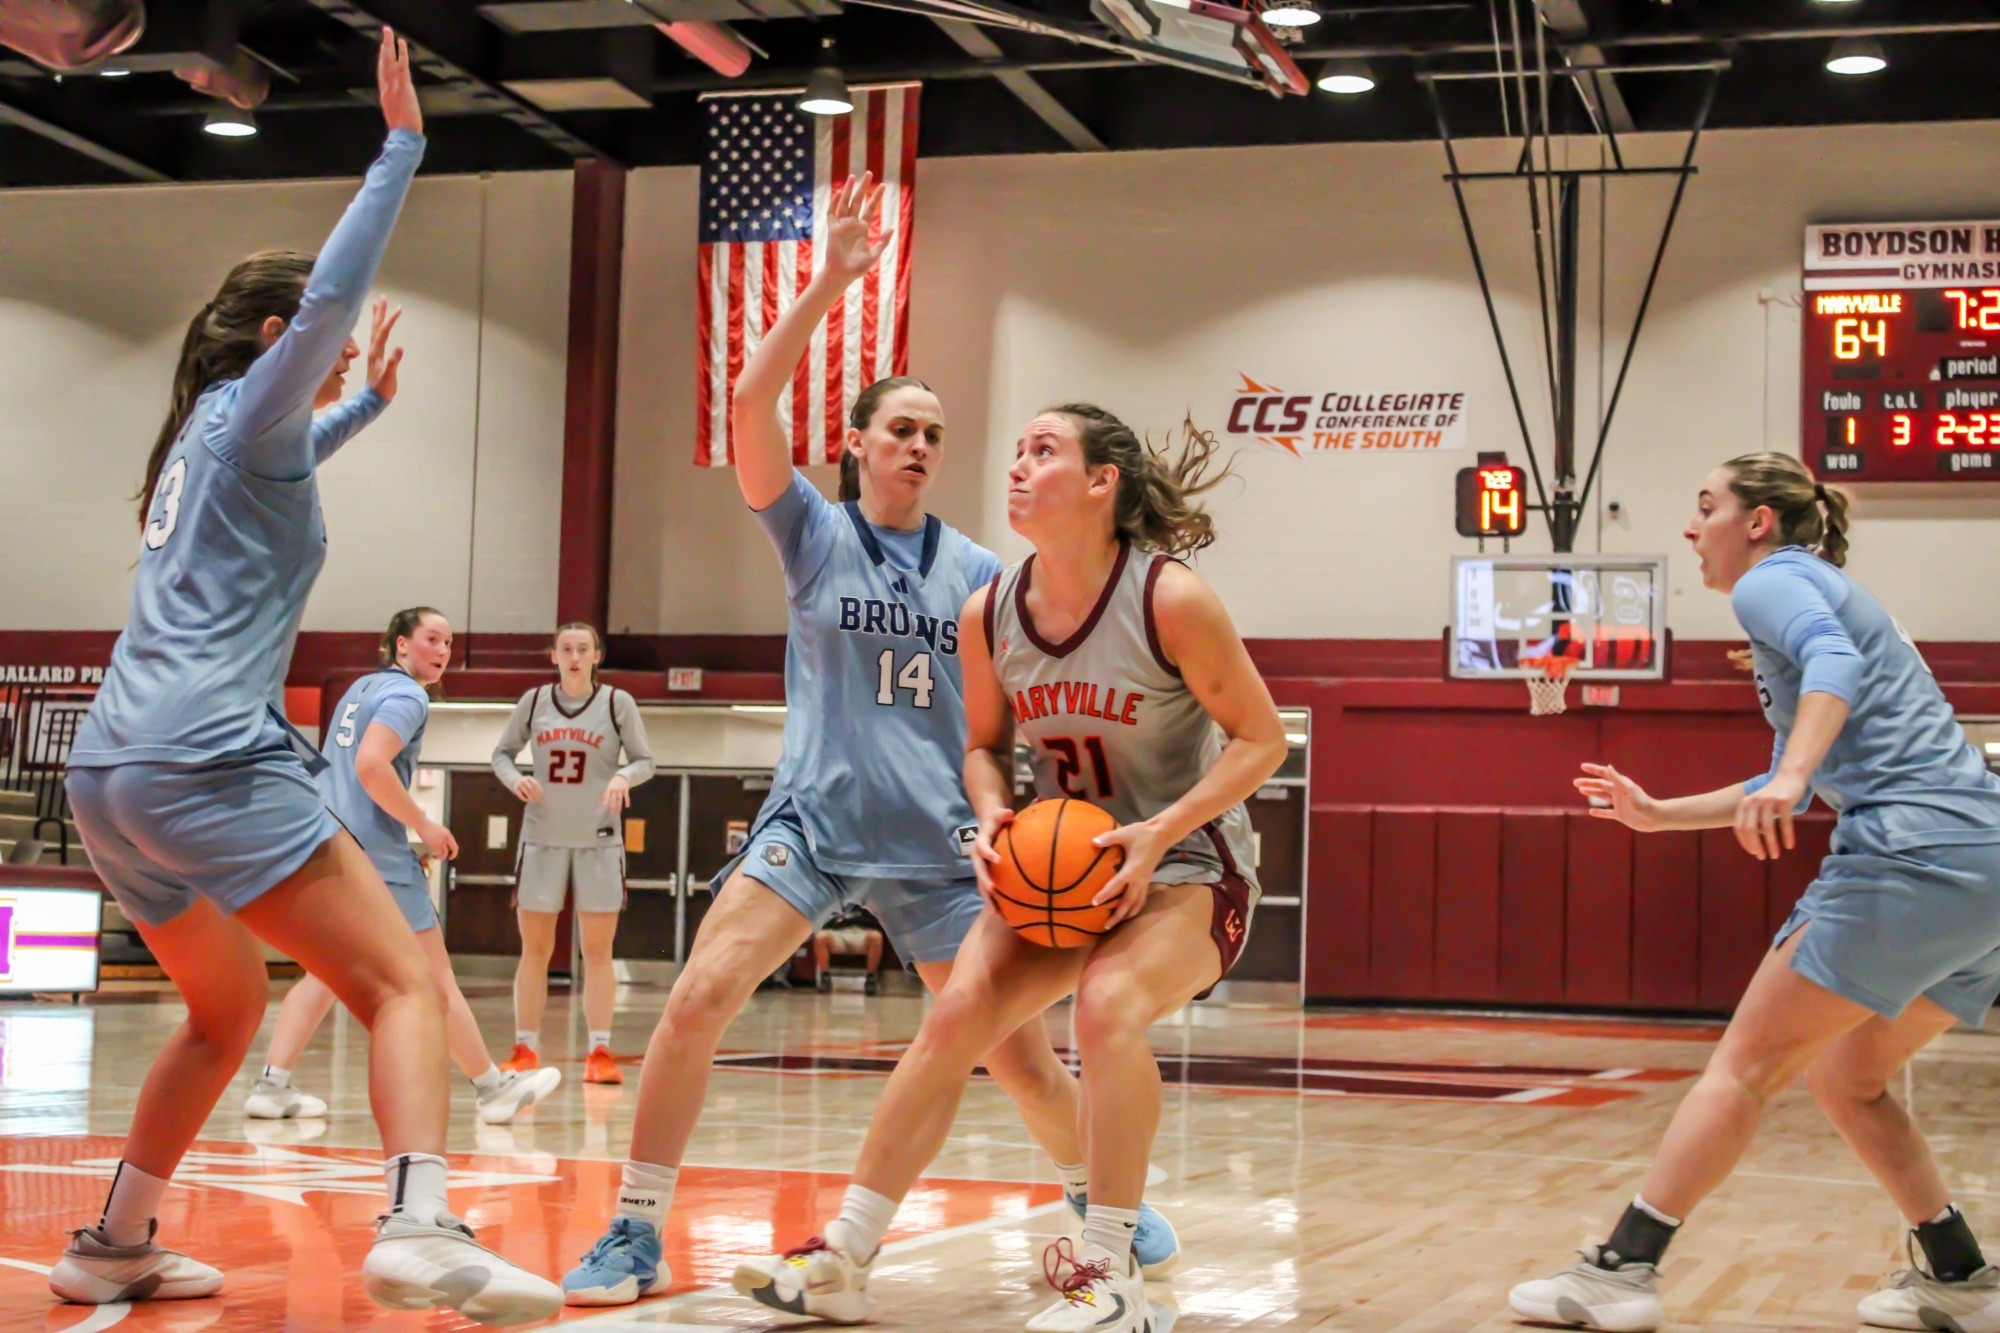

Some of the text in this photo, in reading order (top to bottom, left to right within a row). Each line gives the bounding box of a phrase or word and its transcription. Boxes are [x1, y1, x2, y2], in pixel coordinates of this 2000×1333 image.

[1822, 229, 1972, 257] BOYDSON
[1817, 294, 1901, 314] MARYVILLE
[1834, 318, 1886, 359] 64
[1947, 355, 1998, 379] period
[1320, 391, 1465, 413] COLLEGIATE
[1823, 391, 1862, 410] fouls
[1945, 388, 1999, 411] player
[1226, 395, 1316, 434] CCS
[1315, 413, 1459, 429] CONFERENCE OF
[1312, 430, 1443, 451] THE SOUTH
[1846, 416, 1856, 445] 1
[1892, 414, 1911, 445] 3
[1826, 453, 1858, 469] won
[1951, 453, 1992, 472] game
[1481, 489, 1519, 530] 14
[837, 595, 960, 657] BRUNS
[874, 647, 936, 709] 14
[335, 702, 360, 748] 5
[536, 727, 605, 750] MARYVILLE
[548, 749, 587, 785] 23
[1040, 735, 1115, 802] 21
